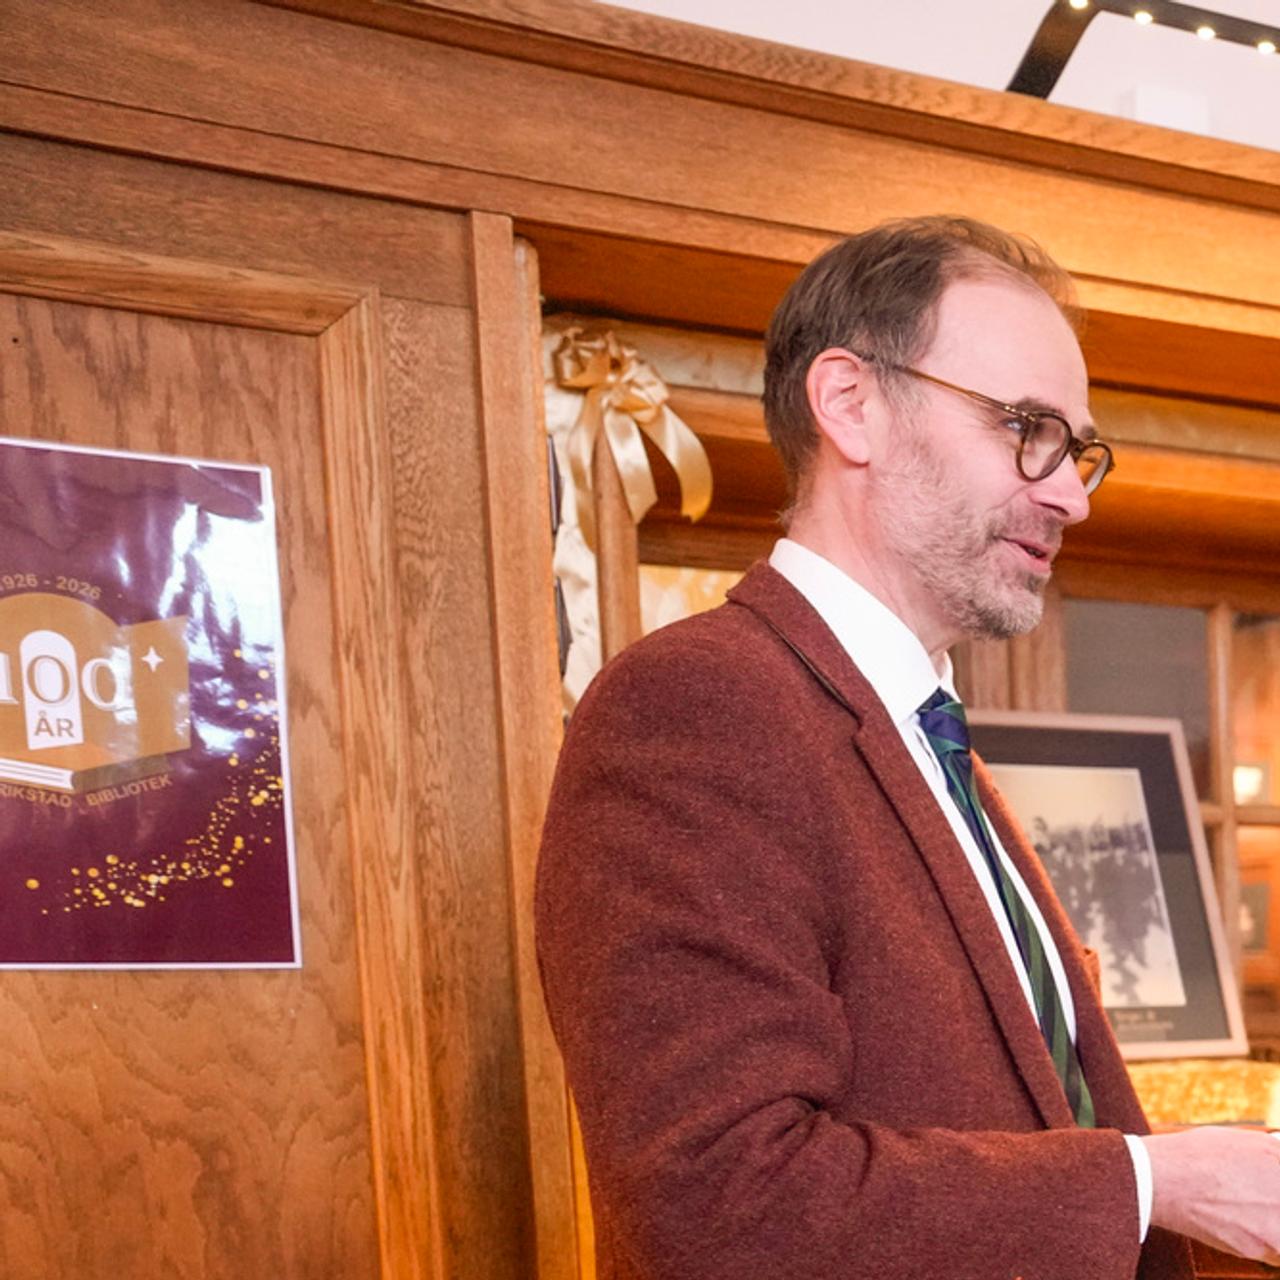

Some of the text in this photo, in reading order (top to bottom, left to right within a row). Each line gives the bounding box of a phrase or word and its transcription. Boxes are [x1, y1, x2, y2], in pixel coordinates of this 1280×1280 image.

[56, 575, 102, 599] 2026
[34, 710, 75, 738] ÅR
[85, 773, 173, 807] BIBLIOTEK
